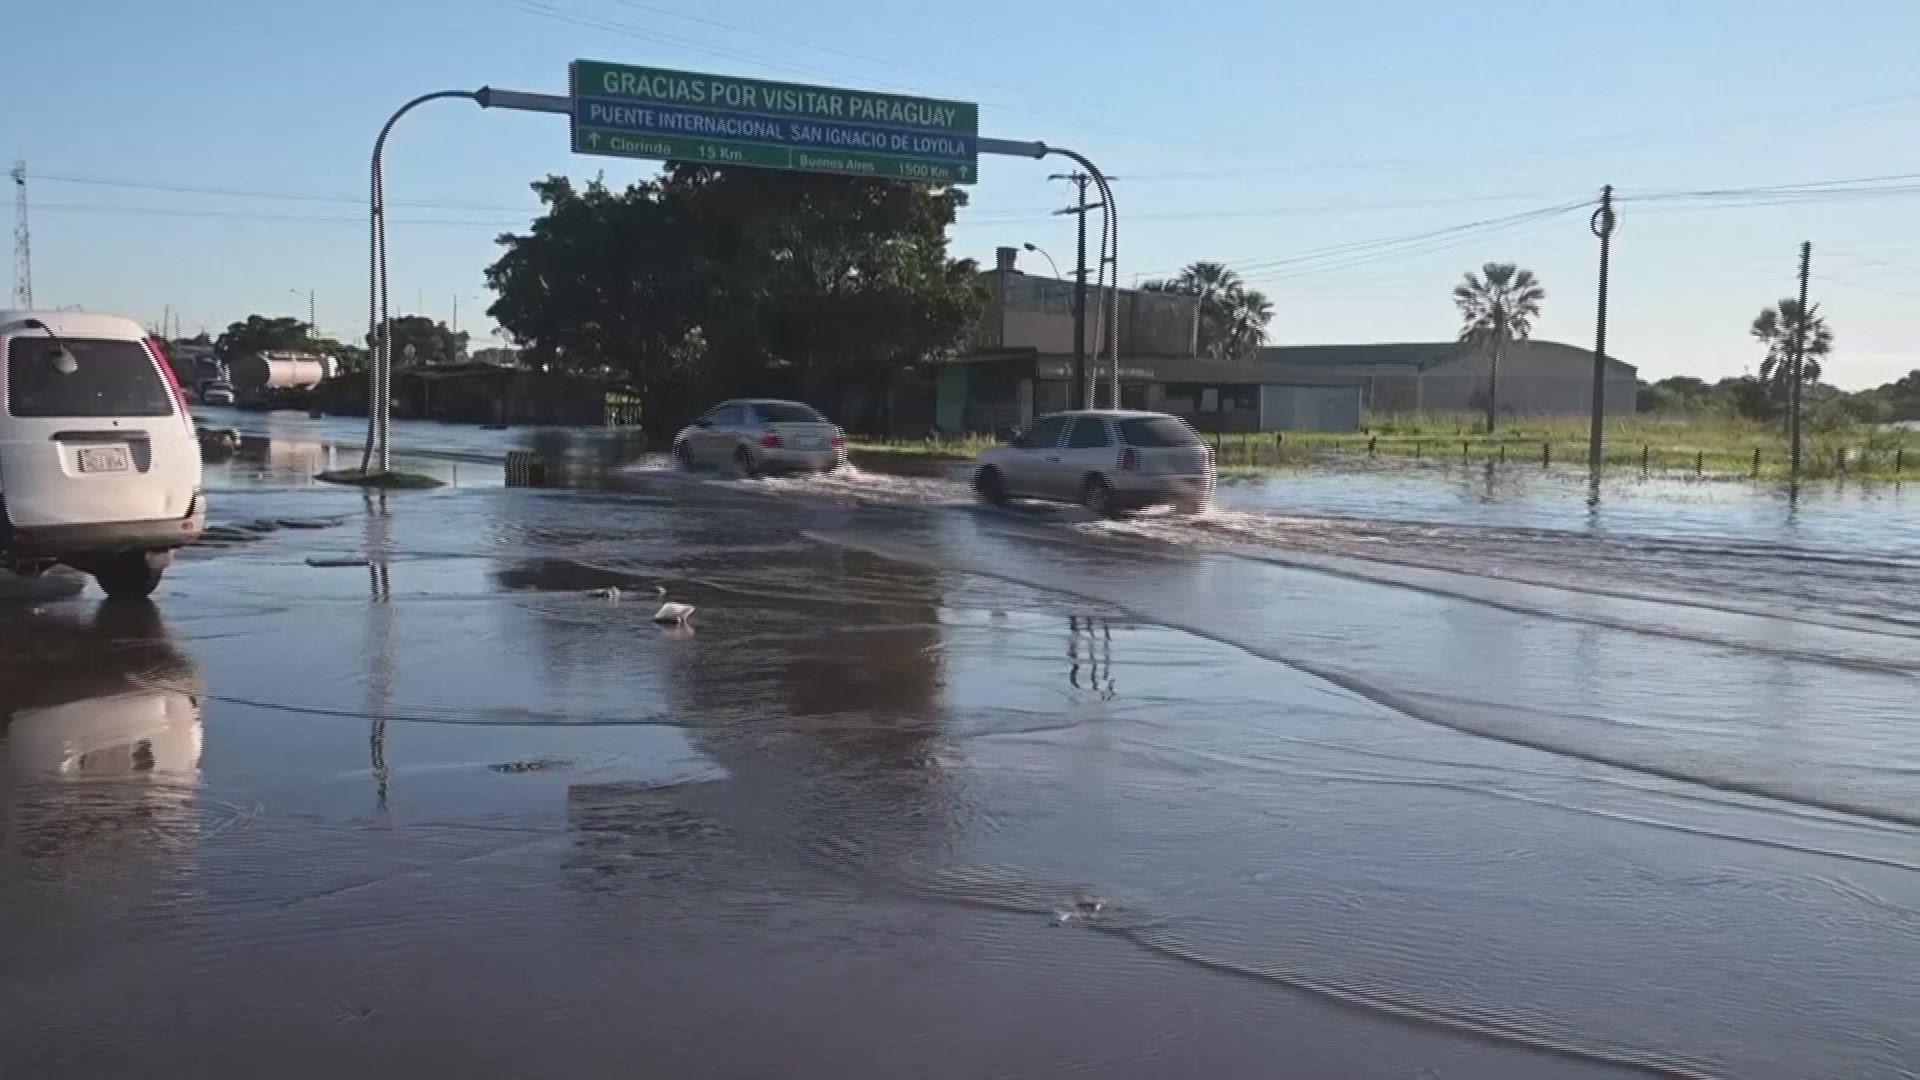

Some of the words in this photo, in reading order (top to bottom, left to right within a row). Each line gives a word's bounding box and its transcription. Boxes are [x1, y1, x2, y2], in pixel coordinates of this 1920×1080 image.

[603, 71, 705, 103] GRACIAS
[711, 81, 756, 108] POR
[763, 87, 843, 116] VISITAR
[850, 97, 956, 127] PARAGUAY
[590, 103, 655, 127] PUENTE
[659, 111, 784, 140] INTERNACIONAL
[790, 124, 822, 142] SAN
[826, 130, 887, 148] IGNACIO
[891, 134, 911, 150] DE
[913, 136, 965, 155] LOYOLA
[610, 136, 672, 155] Clorinda
[698, 144, 717, 159] 15
[720, 146, 743, 161] Km
[799, 153, 843, 169] Buenos
[846, 159, 875, 172] Aires
[899, 163, 928, 177] 1500
